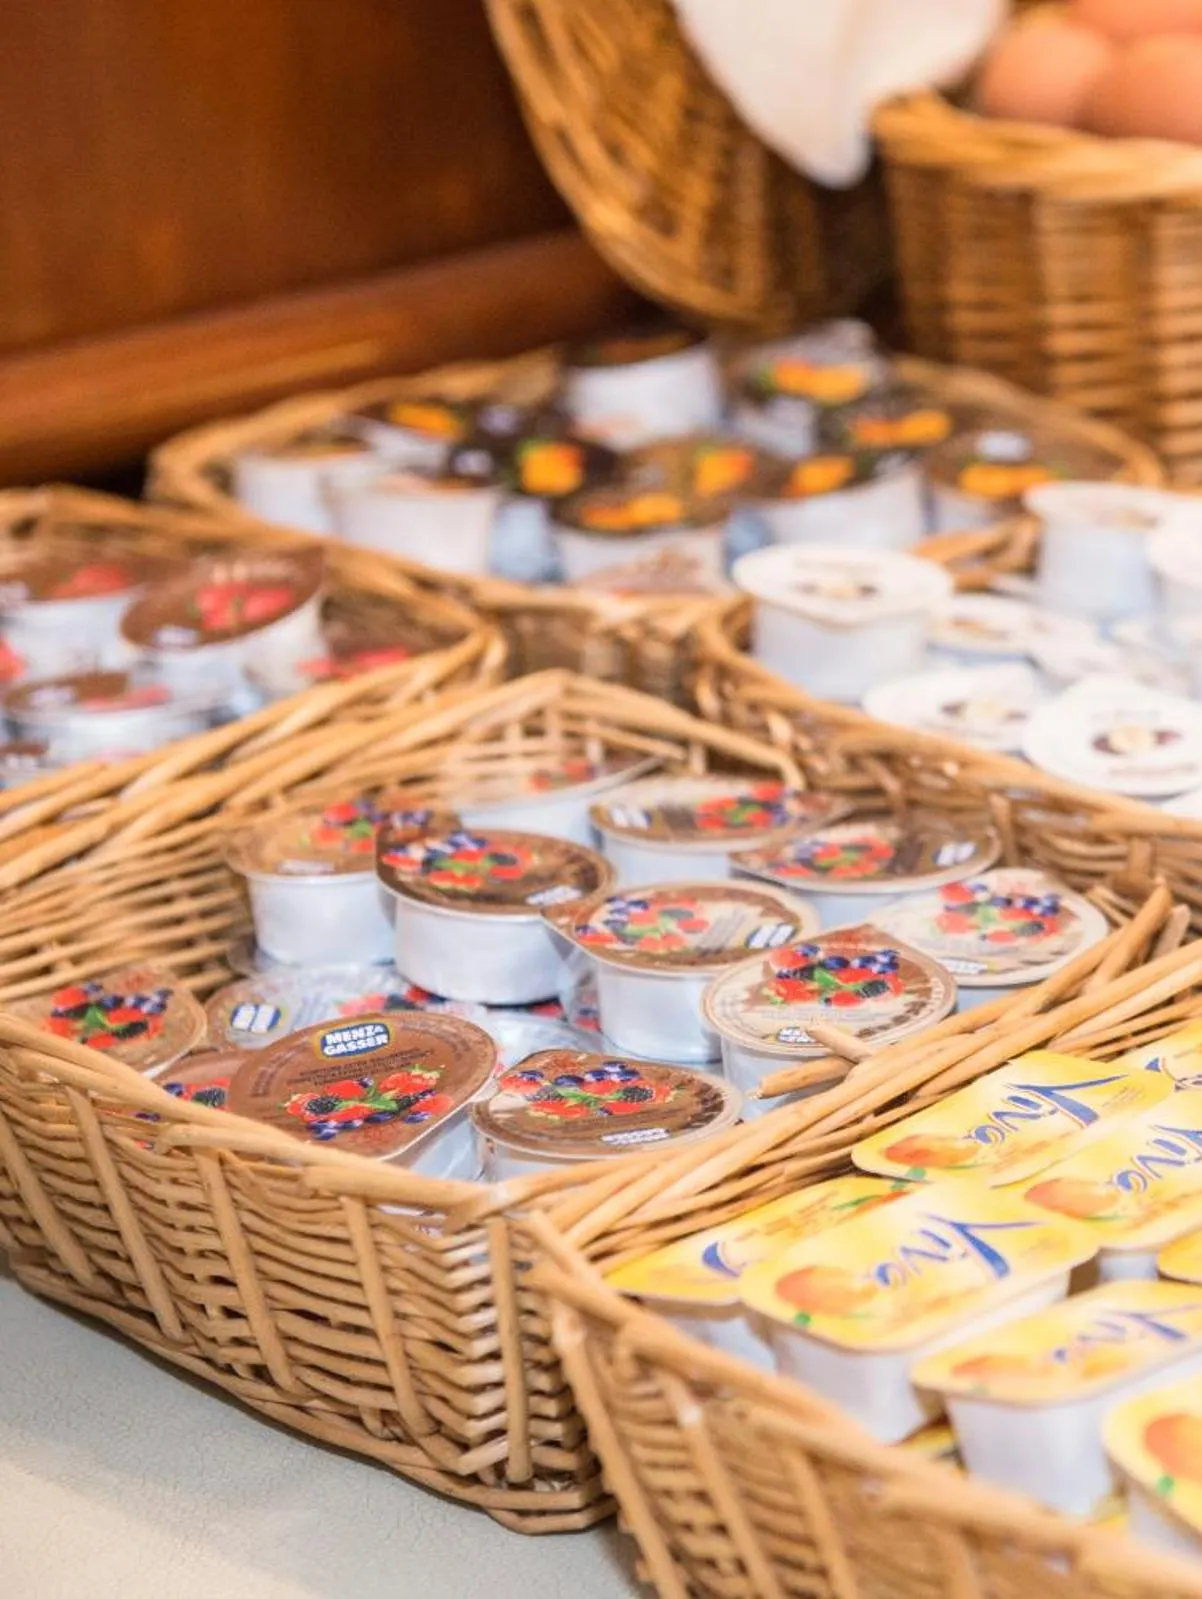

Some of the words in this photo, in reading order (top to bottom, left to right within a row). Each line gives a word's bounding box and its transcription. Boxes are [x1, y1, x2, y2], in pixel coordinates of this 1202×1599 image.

[323, 1033, 389, 1056] GASSER
[963, 1073, 1129, 1145] Viva
[866, 1212, 1050, 1288] Viva
